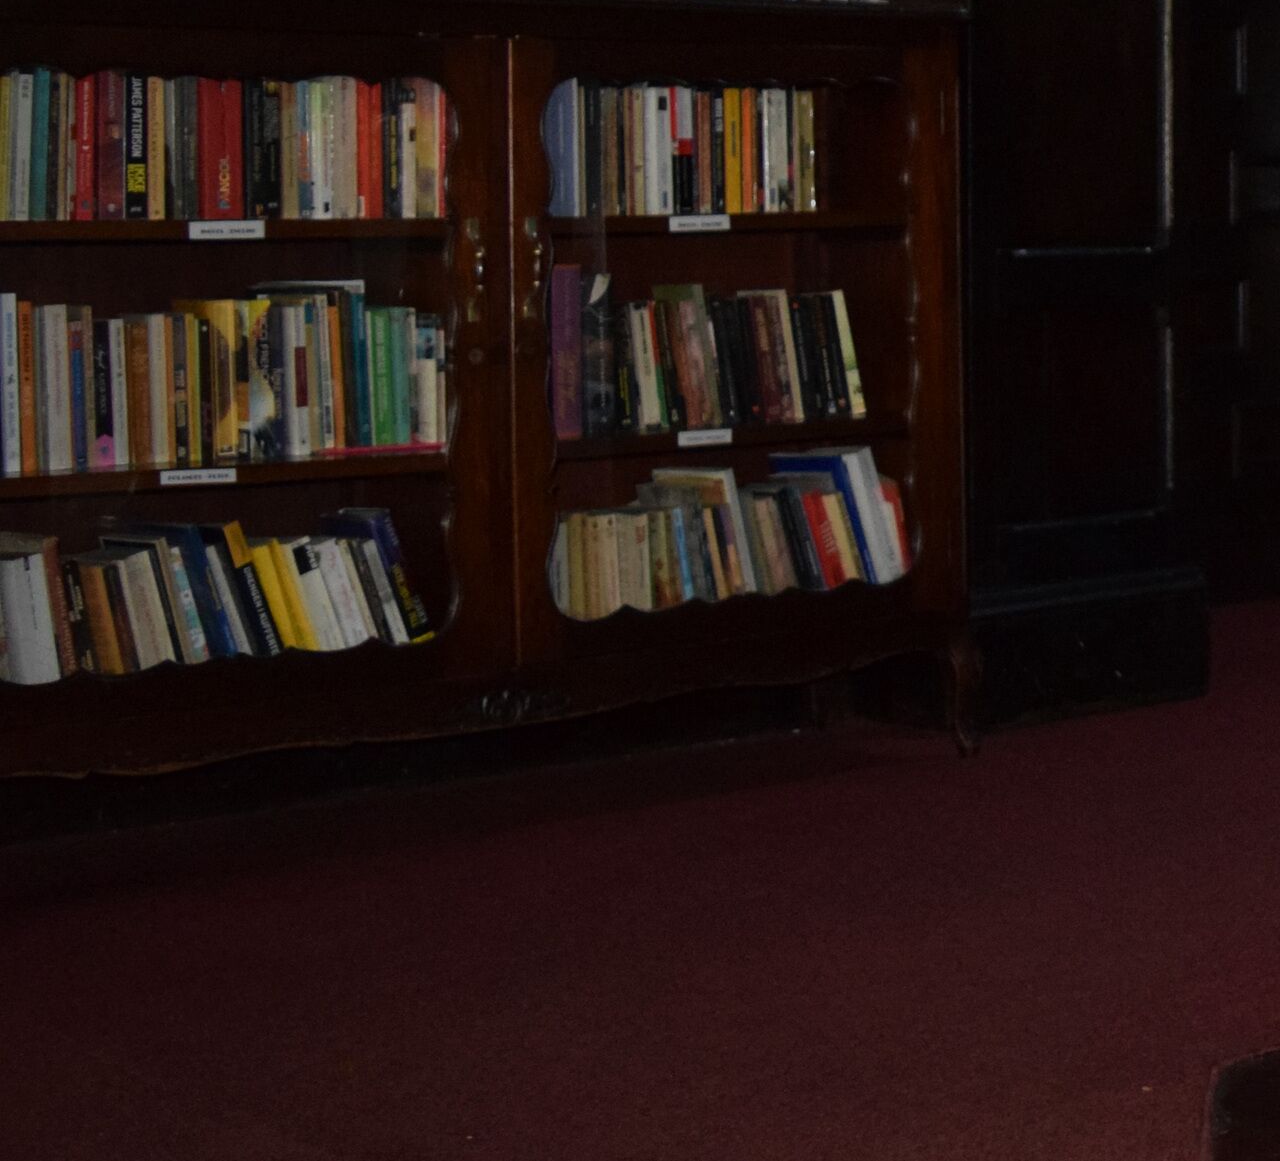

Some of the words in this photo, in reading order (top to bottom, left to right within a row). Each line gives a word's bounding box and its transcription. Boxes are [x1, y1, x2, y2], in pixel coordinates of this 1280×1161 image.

[131, 76, 144, 106] JAMES
[131, 107, 144, 158] PATTERSON
[259, 612, 281, 655] KUFFERTE
